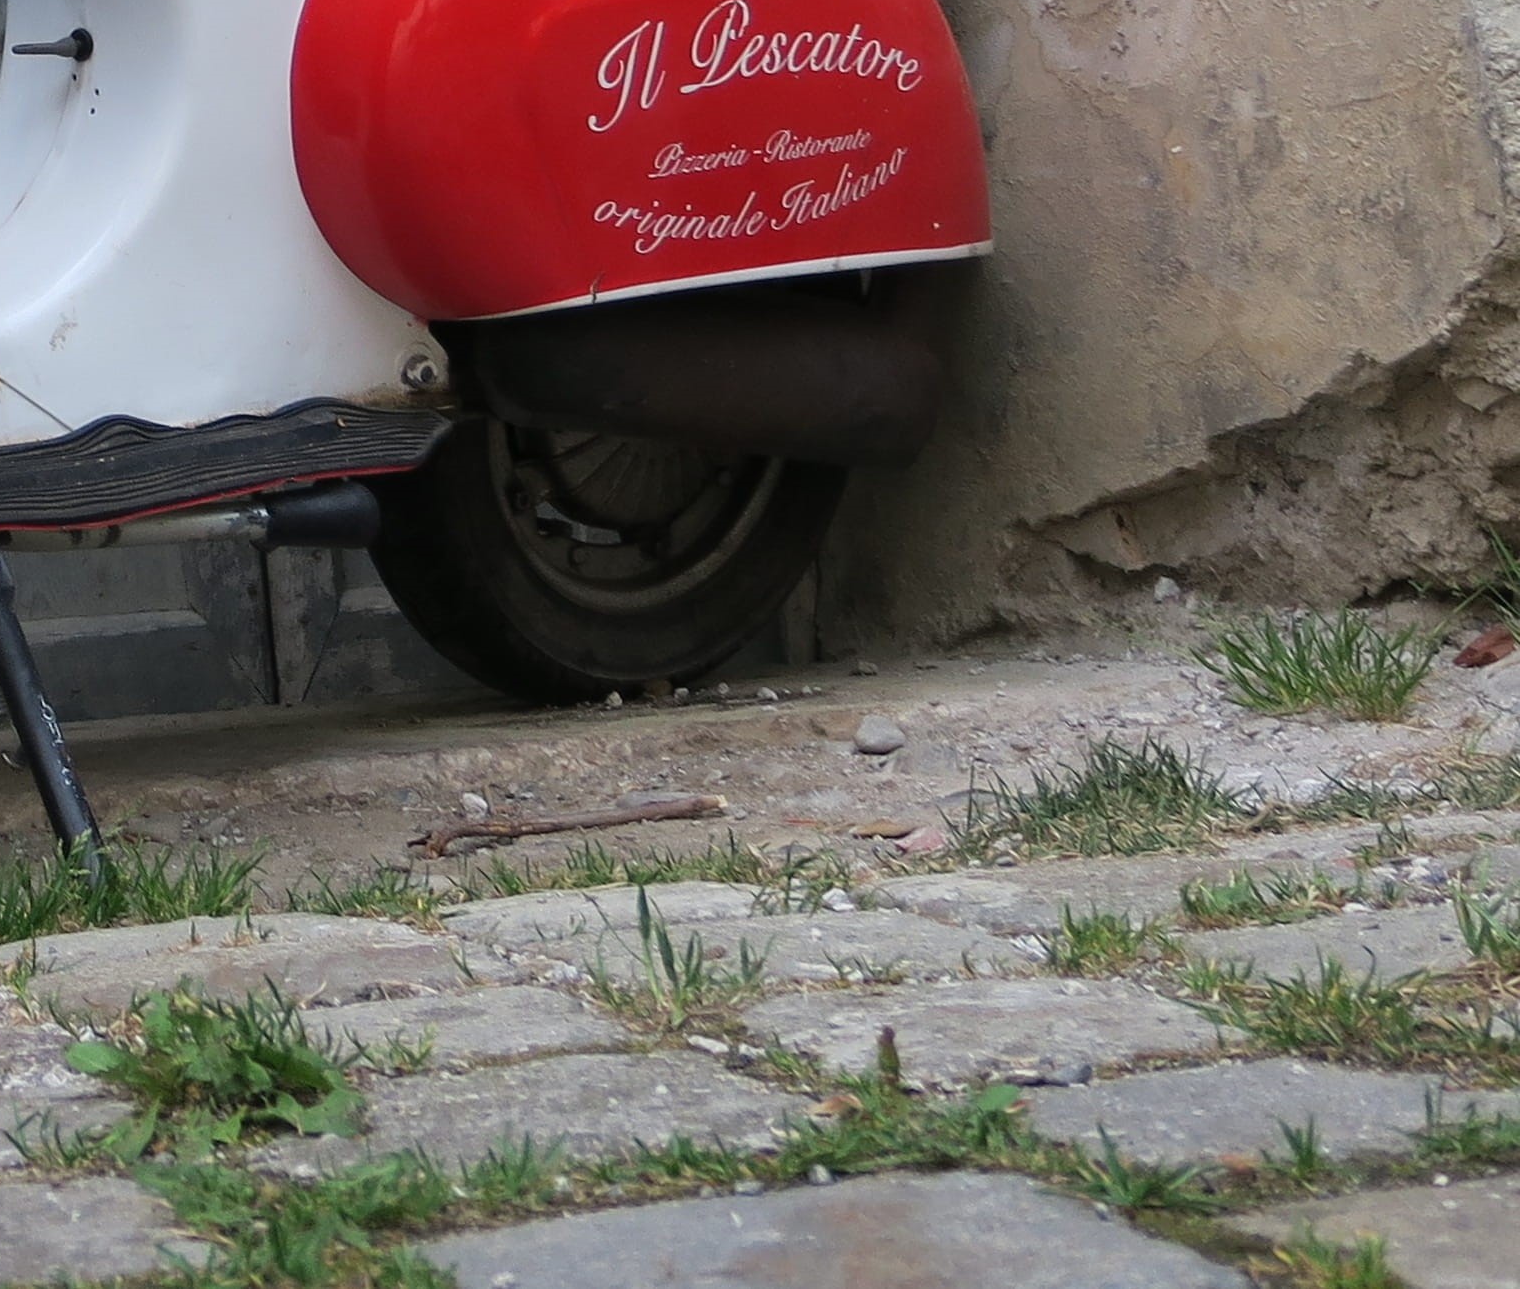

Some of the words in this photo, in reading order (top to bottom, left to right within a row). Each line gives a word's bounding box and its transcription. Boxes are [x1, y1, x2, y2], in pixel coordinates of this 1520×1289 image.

[587, 20, 665, 131] Il
[593, 191, 766, 254] originale
[770, 146, 908, 231] Italiano
